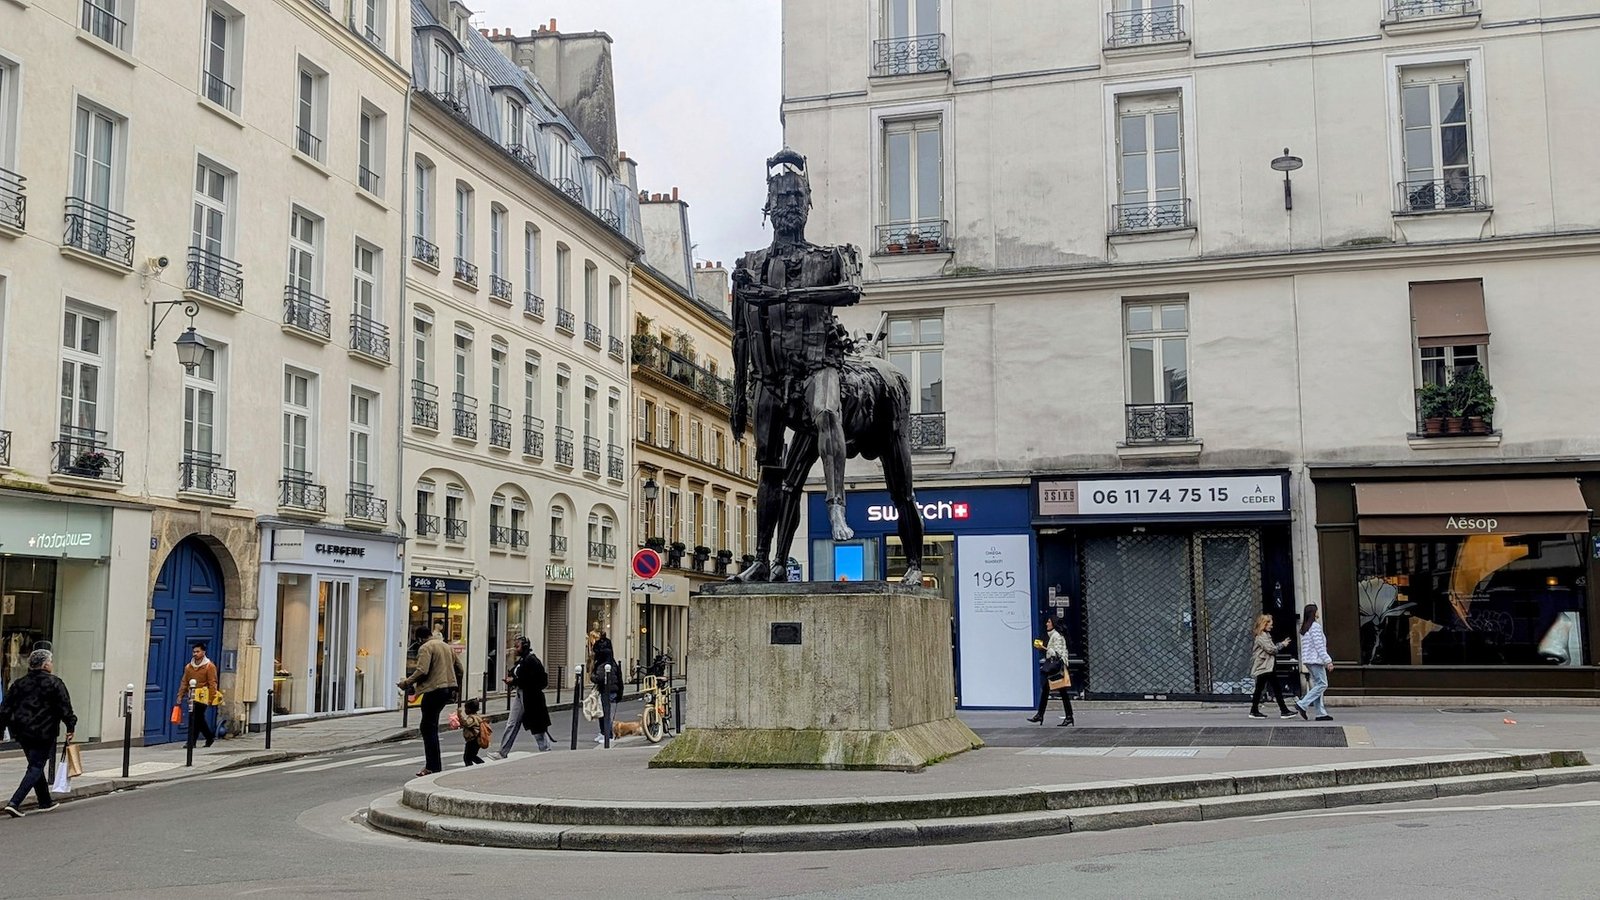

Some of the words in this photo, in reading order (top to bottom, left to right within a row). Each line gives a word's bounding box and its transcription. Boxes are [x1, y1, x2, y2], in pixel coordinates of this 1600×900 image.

[1092, 490, 1119, 504] 06
[1124, 489, 1140, 504] 11
[1147, 489, 1172, 503] 74
[1178, 488, 1203, 503] 75
[1208, 487, 1229, 502] 15
[1254, 484, 1263, 493] À
[1241, 495, 1276, 504] CEDER
[867, 501, 953, 521] swtch
[1445, 516, 1498, 533] Aēsop
[315, 543, 366, 558] CLERGERIE
[973, 570, 1016, 589] 1965
